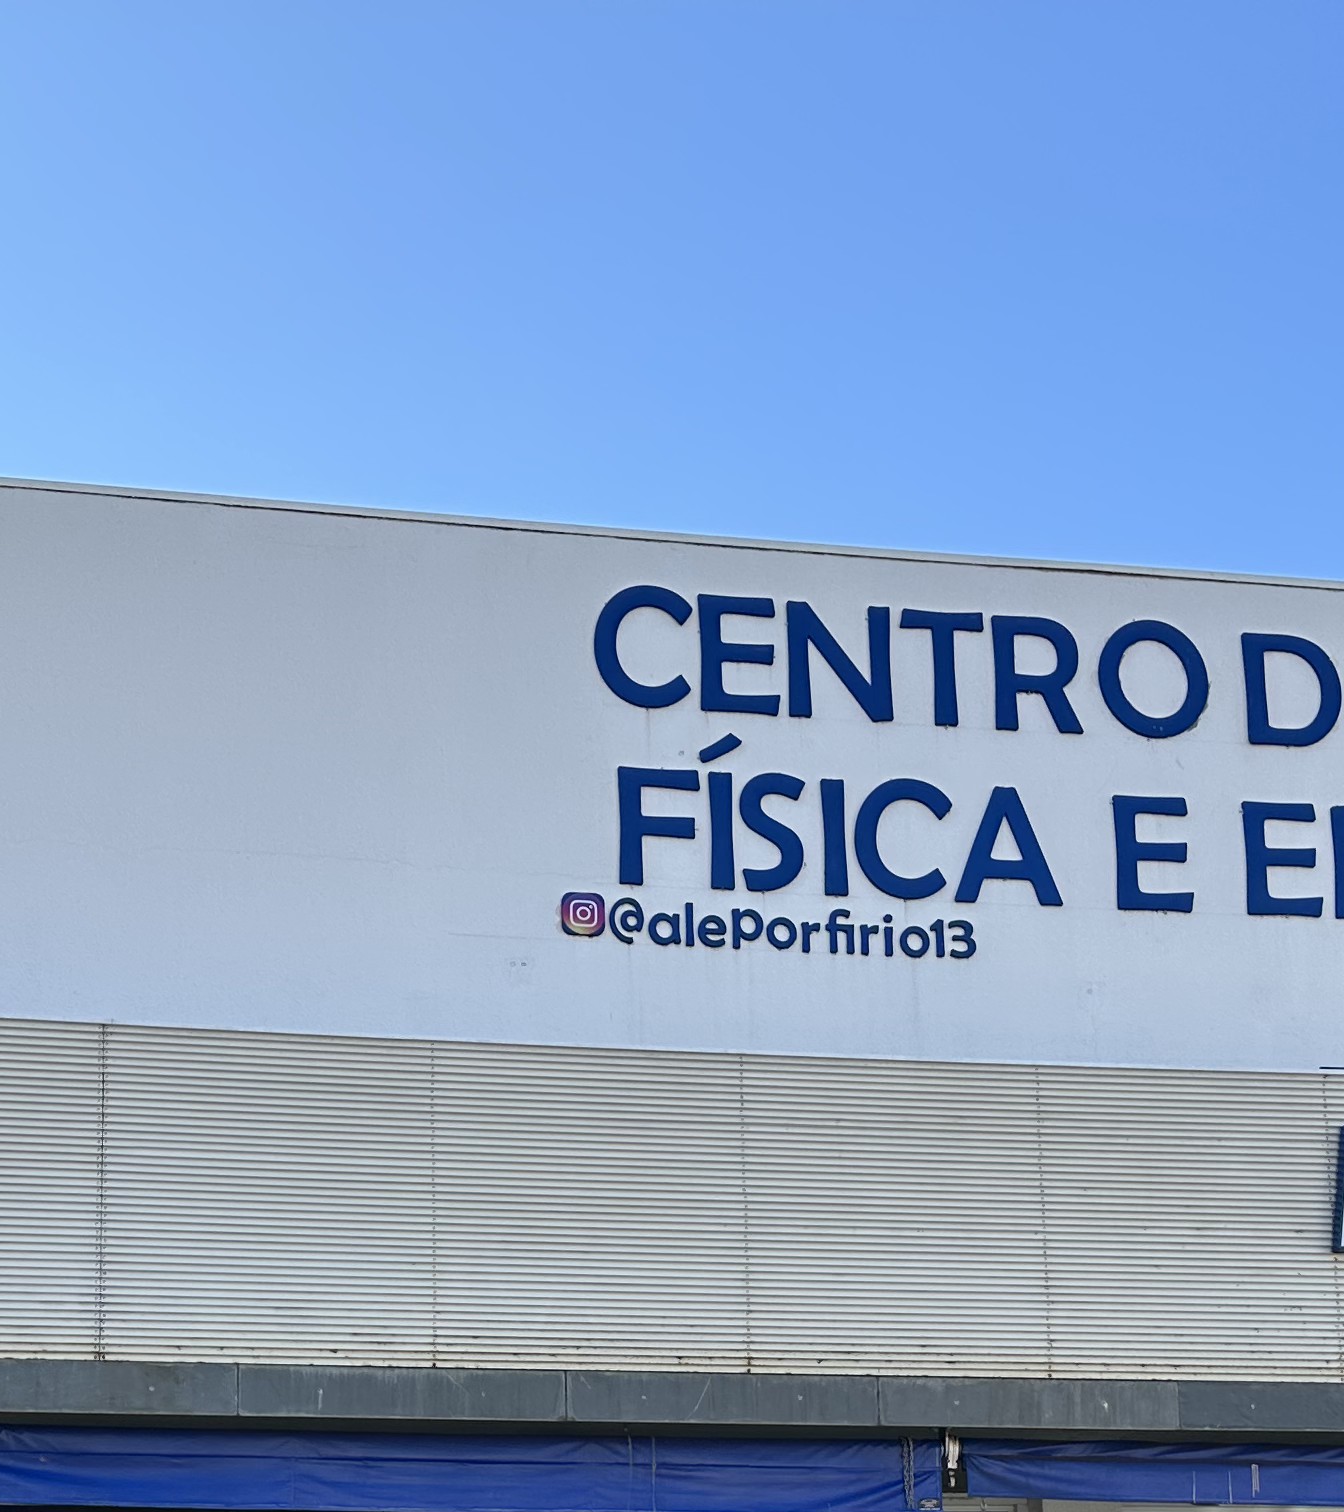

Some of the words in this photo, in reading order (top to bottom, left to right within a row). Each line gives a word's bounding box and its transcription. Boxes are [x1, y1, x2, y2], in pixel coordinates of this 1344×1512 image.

[593, 585, 1210, 739] CENTRO
[617, 732, 1064, 908] FÍSICA
[1111, 794, 1195, 914] E
[608, 894, 977, 959] @alePorfirio13
